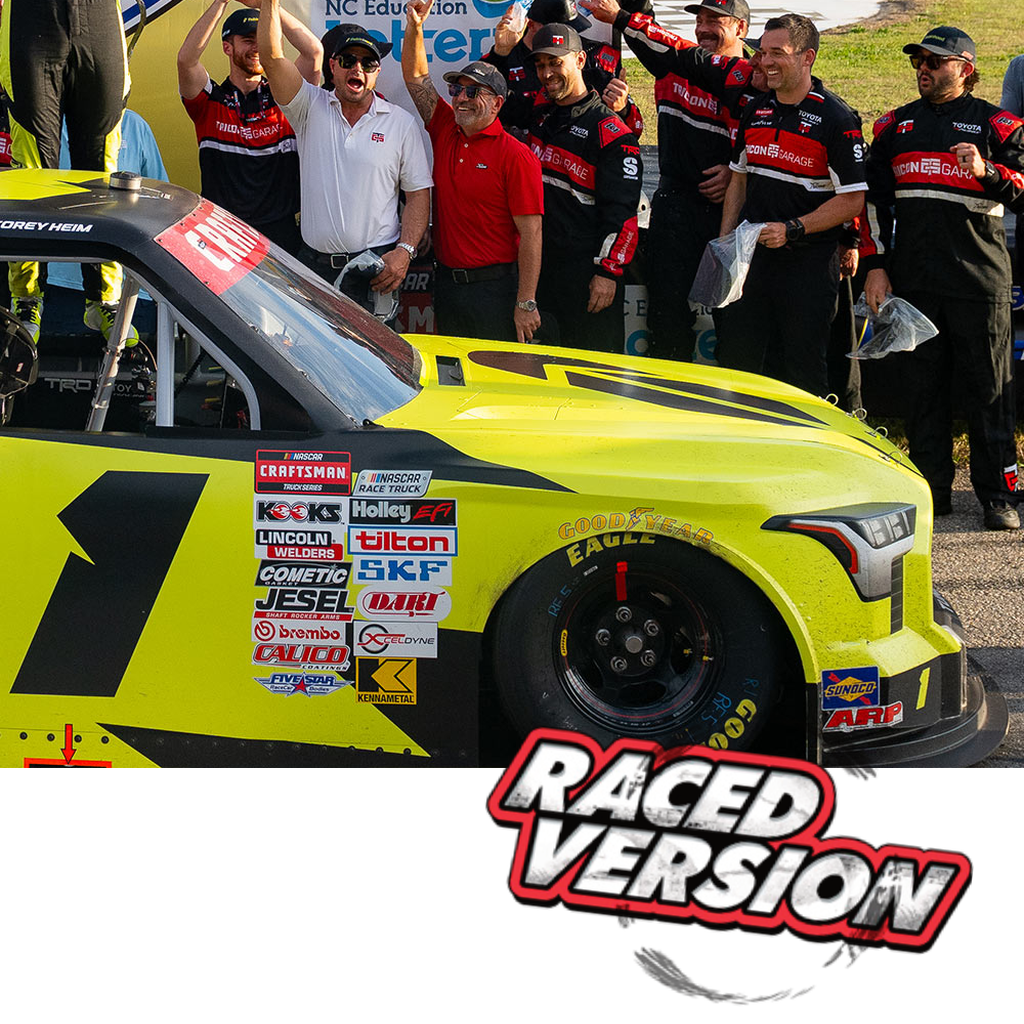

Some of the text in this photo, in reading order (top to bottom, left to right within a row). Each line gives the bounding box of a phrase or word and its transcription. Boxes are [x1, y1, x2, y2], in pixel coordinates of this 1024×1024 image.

[798, 110, 822, 123] TOYOTA
[952, 122, 982, 132] TOYOTA
[779, 149, 815, 168] GARAGE
[49, 222, 93, 233] HEIM
[45, 378, 91, 393] TRD
[293, 453, 323, 461] NASCAR
[260, 465, 346, 479] CRAFTSMAN
[379, 473, 421, 483] NASCAR
[359, 485, 422, 493] RACE TRUCK
[257, 501, 342, 523] KOOKS
[352, 501, 411, 524] Holley
[558, 511, 714, 545] GOODYEAR
[259, 531, 328, 546] LINCOLN
[355, 531, 449, 552] tilton
[275, 548, 335, 559] WELDERS
[565, 532, 656, 567] EAGLE
[260, 564, 347, 584] COMETIC
[358, 559, 448, 581] SKF
[10, 470, 210, 698] 1
[255, 589, 350, 613] JESEL
[368, 591, 446, 611] DART
[279, 625, 341, 641] brembo
[357, 632, 435, 645] XCELDYNE
[255, 644, 349, 664] CALICO
[271, 674, 335, 686] FIVE STAR
[826, 681, 876, 696] SUNOCO
[916, 667, 930, 710] 1
[358, 694, 414, 704] KENNAMETAL
[825, 702, 902, 728] ARP
